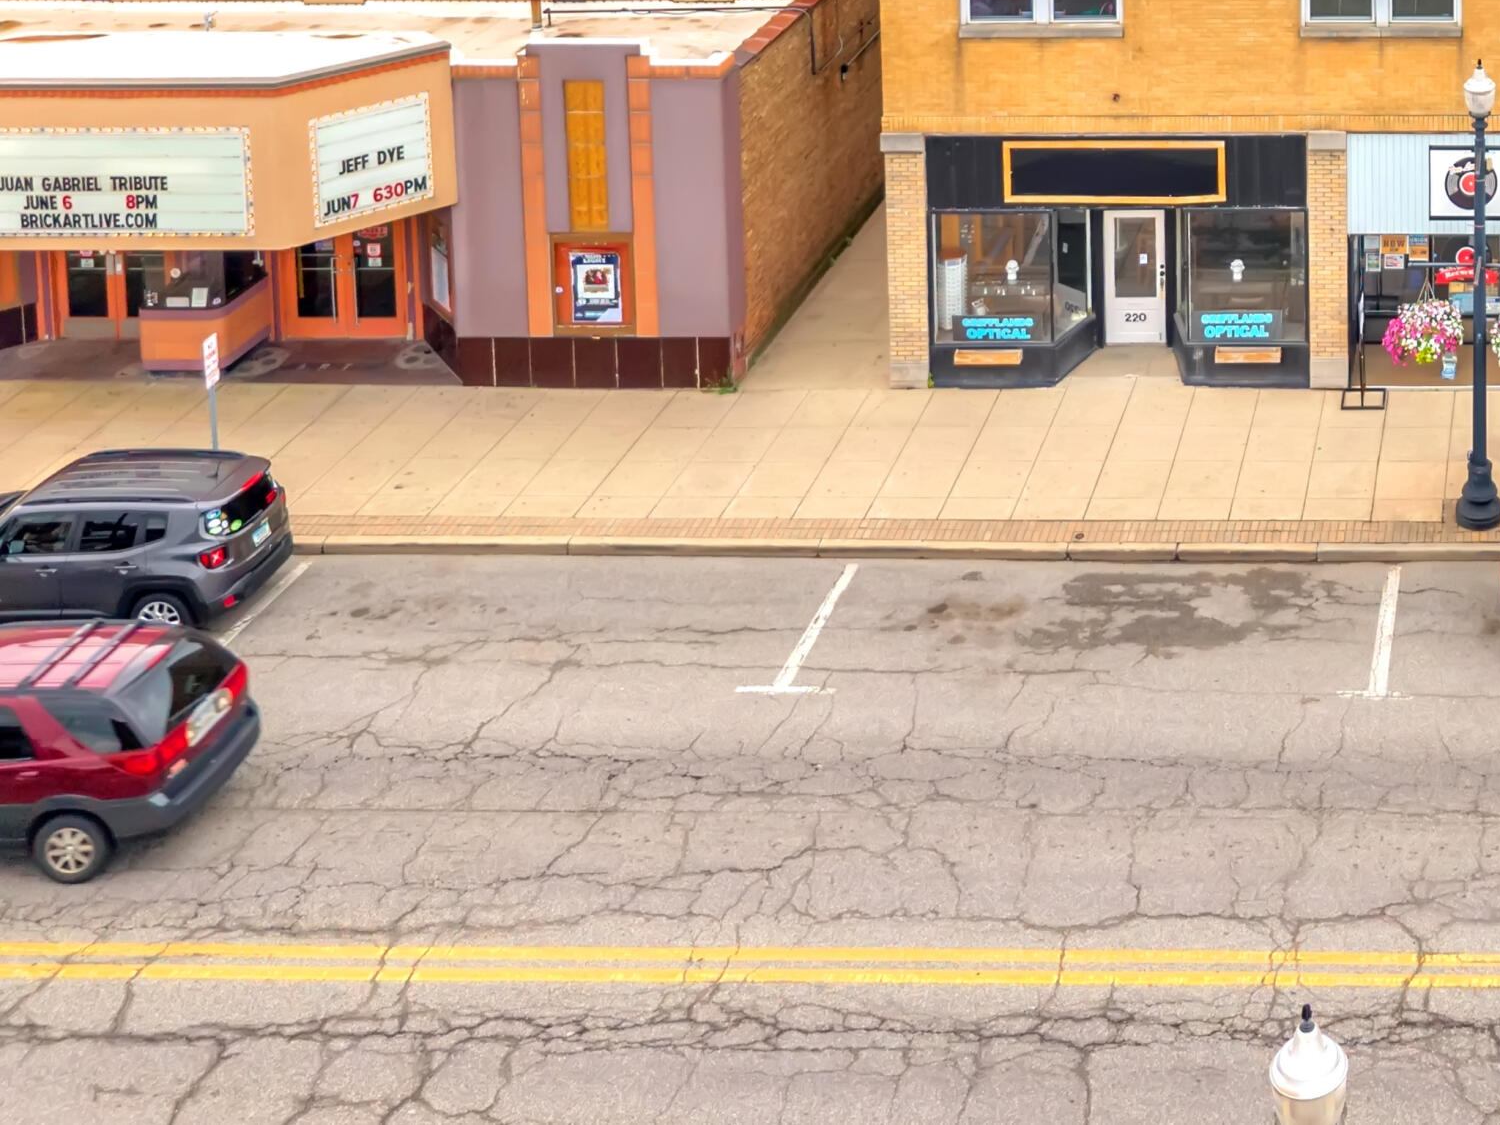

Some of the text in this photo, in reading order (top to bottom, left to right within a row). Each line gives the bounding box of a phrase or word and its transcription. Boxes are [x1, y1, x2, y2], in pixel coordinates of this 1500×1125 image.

[339, 145, 404, 175] JEFF DYE
[0, 176, 168, 192] JUAN GABRIEL TRIBUTE
[373, 175, 427, 202] 630PM
[24, 194, 157, 210] JUNE 6 8PM
[21, 212, 157, 229] BRICKARTLIVE.COM
[1124, 312, 1147, 323] 220
[966, 328, 1031, 339] OPTICAL
[1204, 325, 1269, 338] OPTICAL
